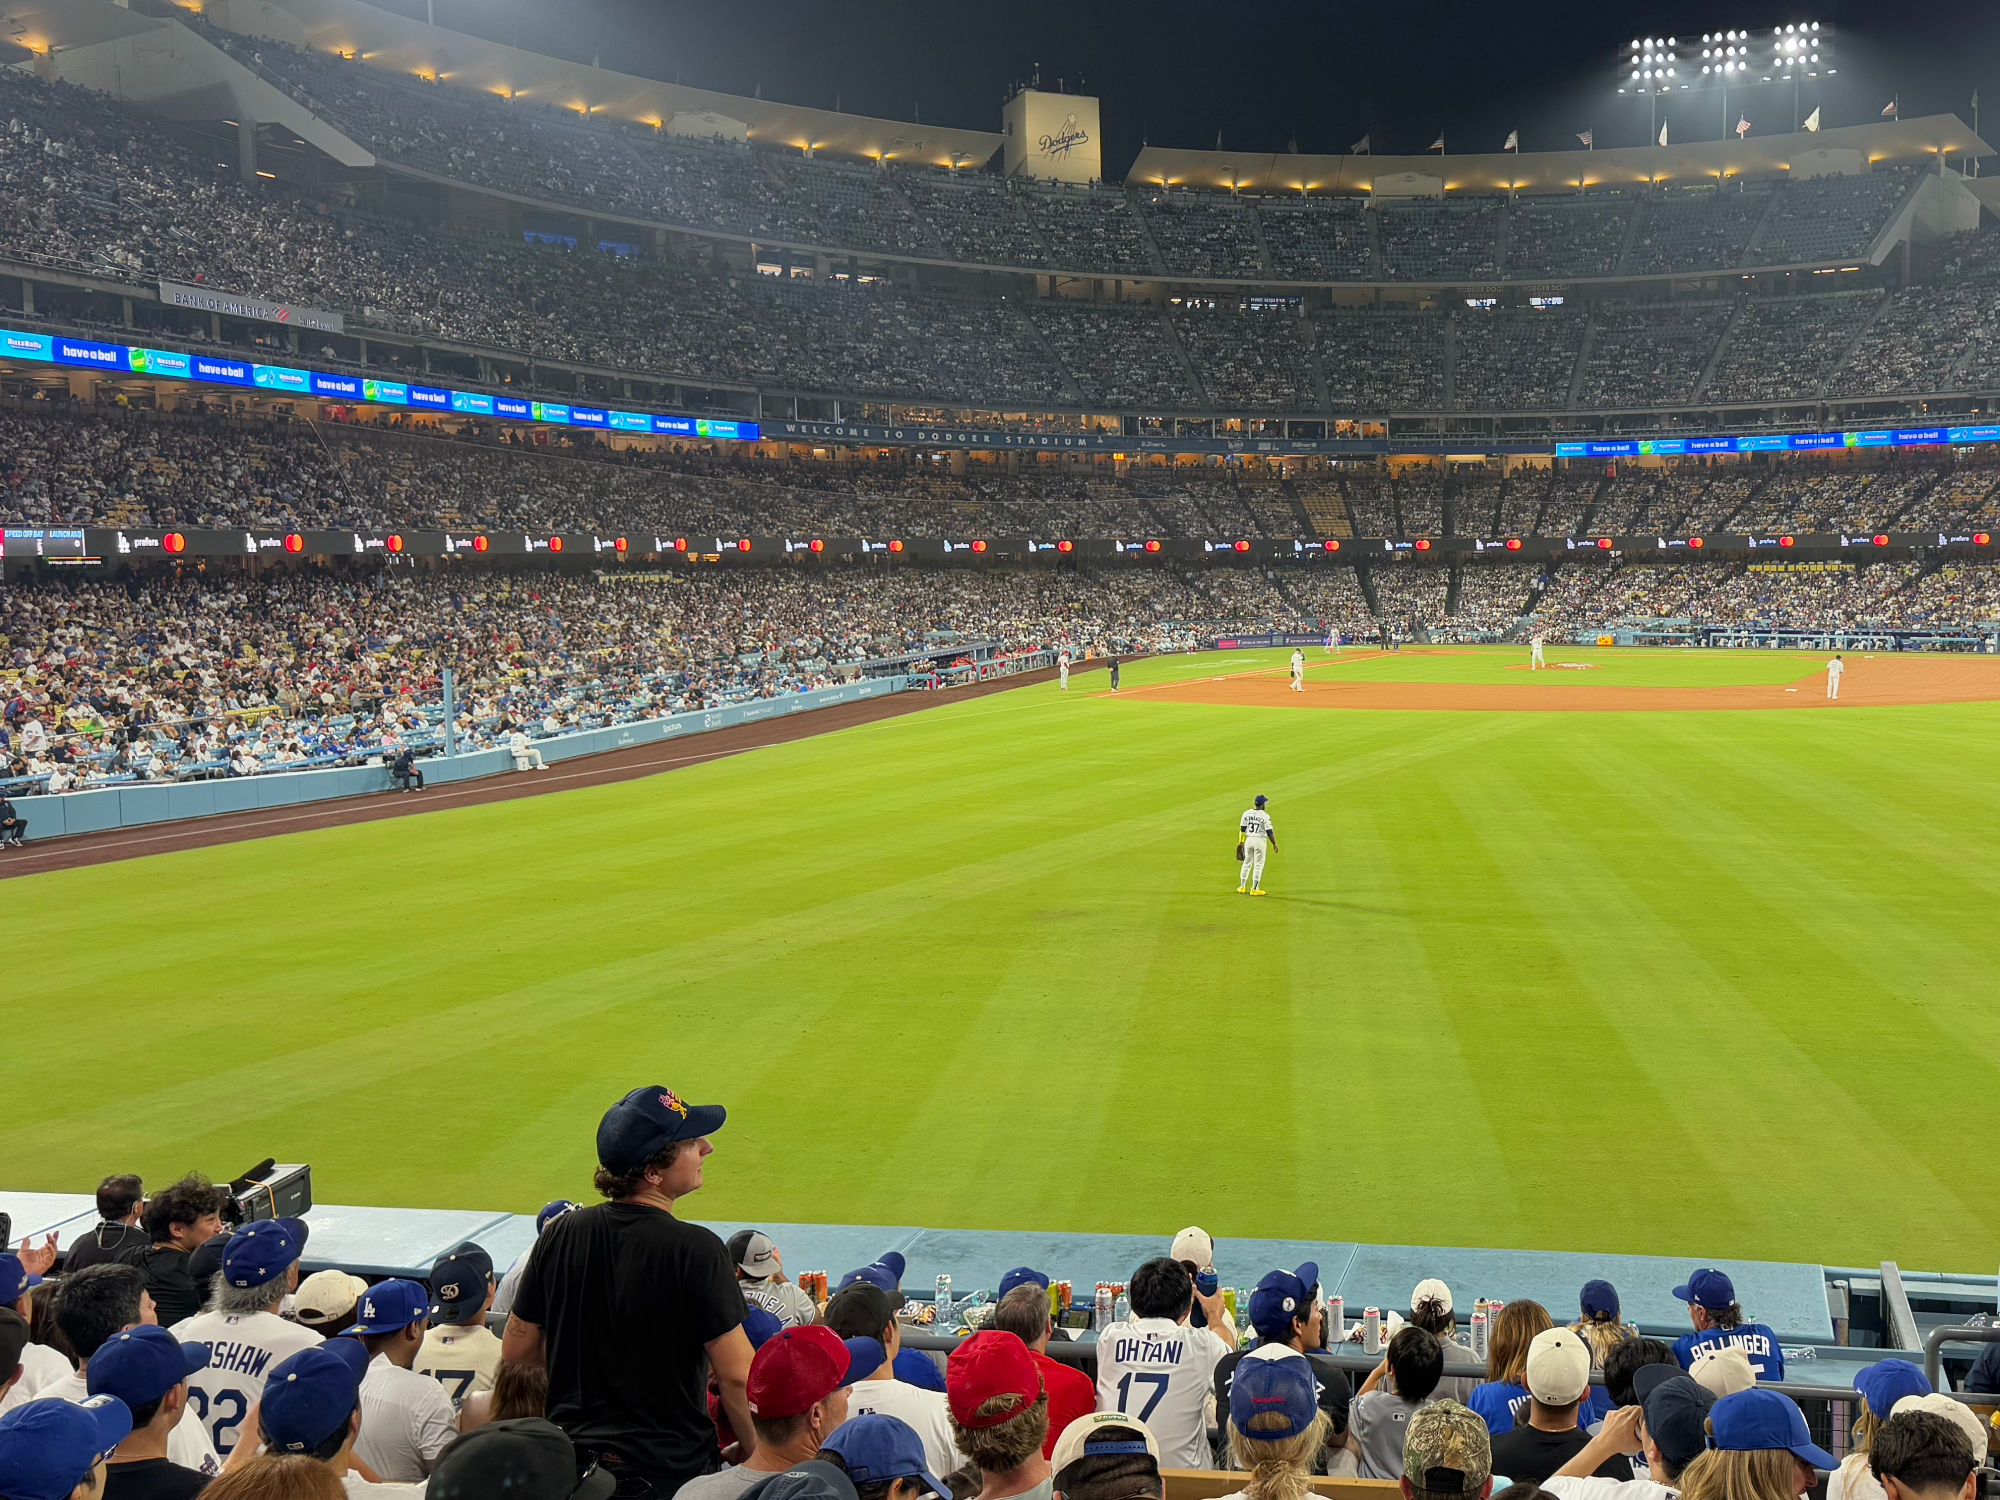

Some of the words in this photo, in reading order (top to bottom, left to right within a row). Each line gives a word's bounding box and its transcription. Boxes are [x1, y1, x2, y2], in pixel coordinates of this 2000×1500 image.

[1039, 130, 1088, 153] Dodgers
[174, 292, 203, 308] BANK
[206, 298, 221, 310] OF
[223, 301, 270, 319] AMERICA
[63, 344, 89, 358] have
[90, 350, 97, 358] a
[98, 350, 117, 362] ball
[199, 362, 220, 375] have
[228, 366, 244, 378] ball
[317, 378, 335, 390] have
[336, 382, 341, 390] a
[342, 382, 355, 392] ball
[786, 424, 869, 437] WELCOME
[884, 430, 903, 439] TO
[918, 432, 990, 443] DODGER
[1006, 436, 1087, 446] STADIUM
[134, 537, 159, 548] prefers
[260, 537, 281, 548] prefers
[366, 538, 384, 548] prefers
[1248, 822, 1260, 834] 37
[364, 1297, 376, 1318] LA
[1116, 1338, 1183, 1364] OHTANI
[1116, 1372, 1170, 1424] 17
